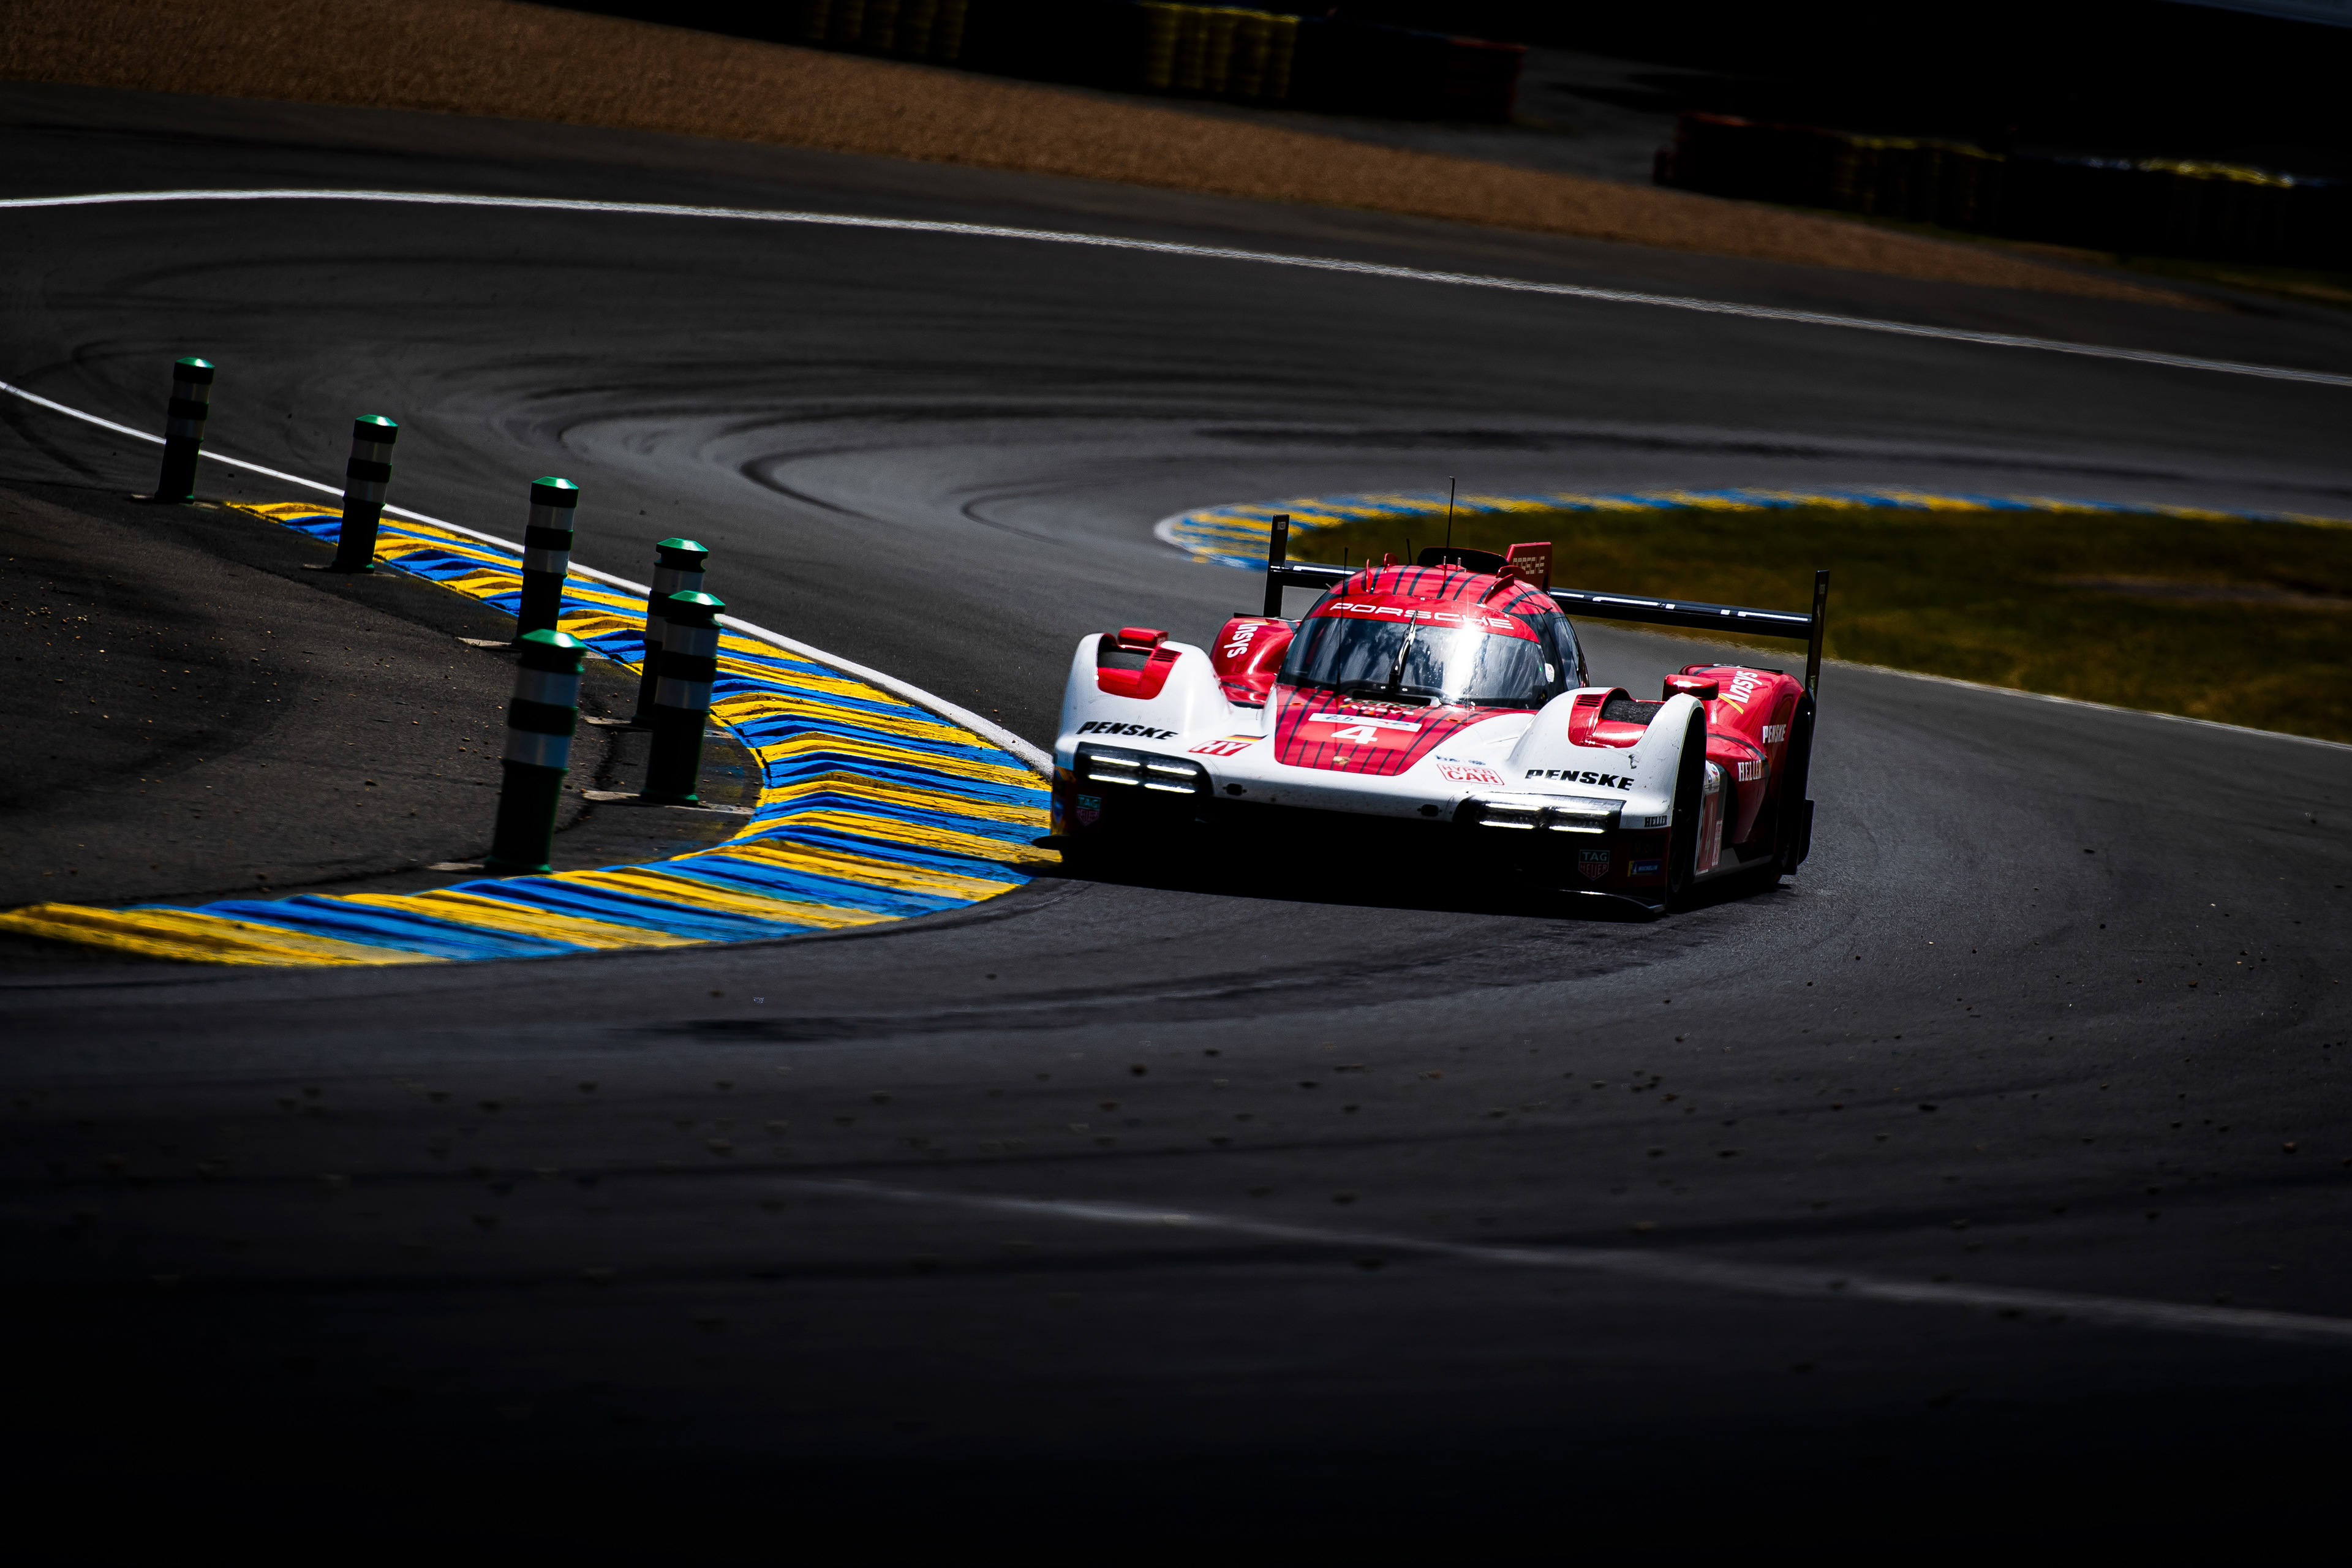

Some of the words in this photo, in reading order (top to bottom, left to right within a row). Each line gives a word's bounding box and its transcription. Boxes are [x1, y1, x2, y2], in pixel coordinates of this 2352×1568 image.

[1329, 602, 1515, 630] PORSCHE
[1076, 721, 1179, 740] PENSKE
[1330, 725, 1378, 745] 4
[1762, 724, 1787, 744] PENSKE
[1191, 741, 1248, 755] HY
[1441, 764, 1493, 775] HYPER
[1447, 771, 1499, 783] CAR
[1737, 759, 1762, 782] HELLER
[1525, 769, 1635, 791] PENSKE
[1644, 815, 1667, 827] HELLER
[1582, 852, 1608, 861] TAG
[1580, 862, 1608, 878] HEUER
